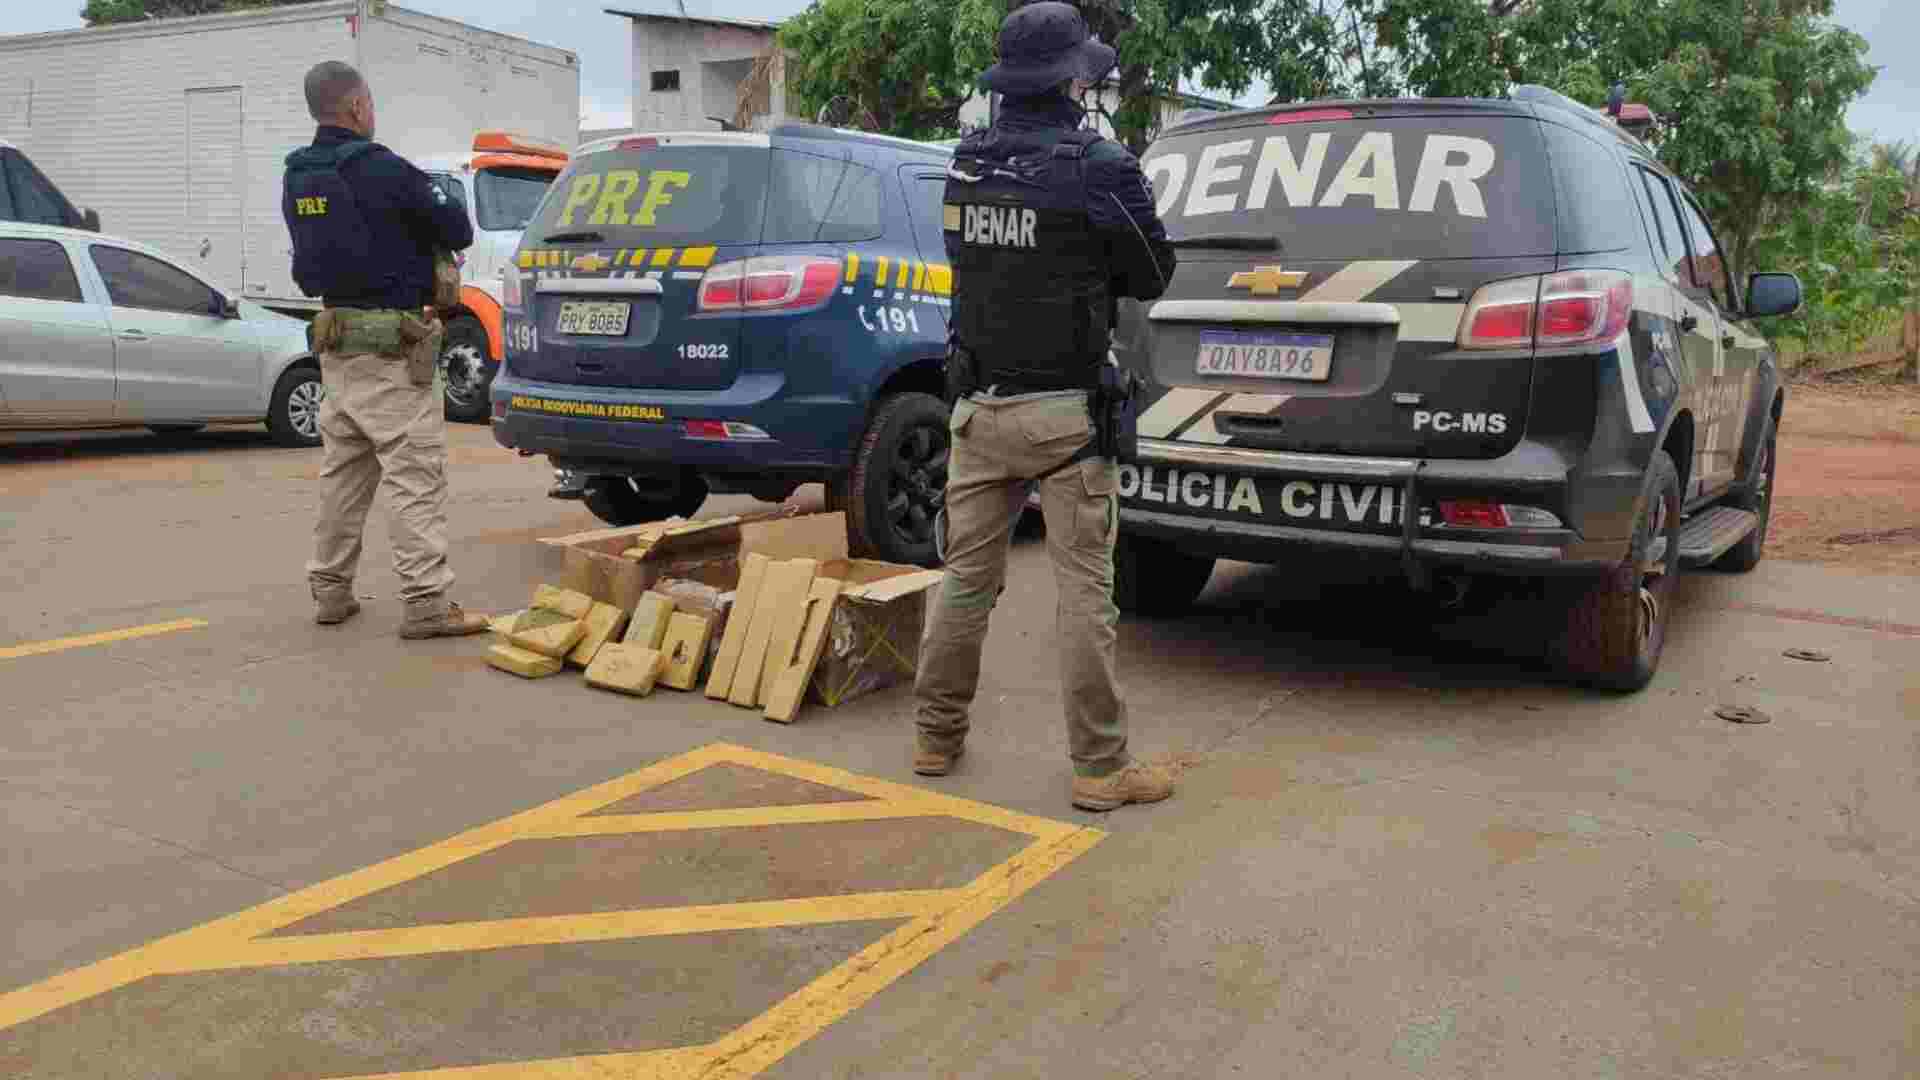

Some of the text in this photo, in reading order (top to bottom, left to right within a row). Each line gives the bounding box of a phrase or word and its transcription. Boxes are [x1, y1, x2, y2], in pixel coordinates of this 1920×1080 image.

[1139, 131, 1495, 218] DENAR
[296, 197, 328, 215] PRF
[557, 170, 689, 225] PRF
[964, 204, 1037, 247] DENAR
[876, 306, 920, 333] 191
[513, 320, 538, 352] 191
[677, 344, 729, 359] 18022
[607, 404, 665, 418] FEDERAL
[1413, 411, 1507, 434] PC-MS
[1118, 463, 1263, 513] OLICIA
